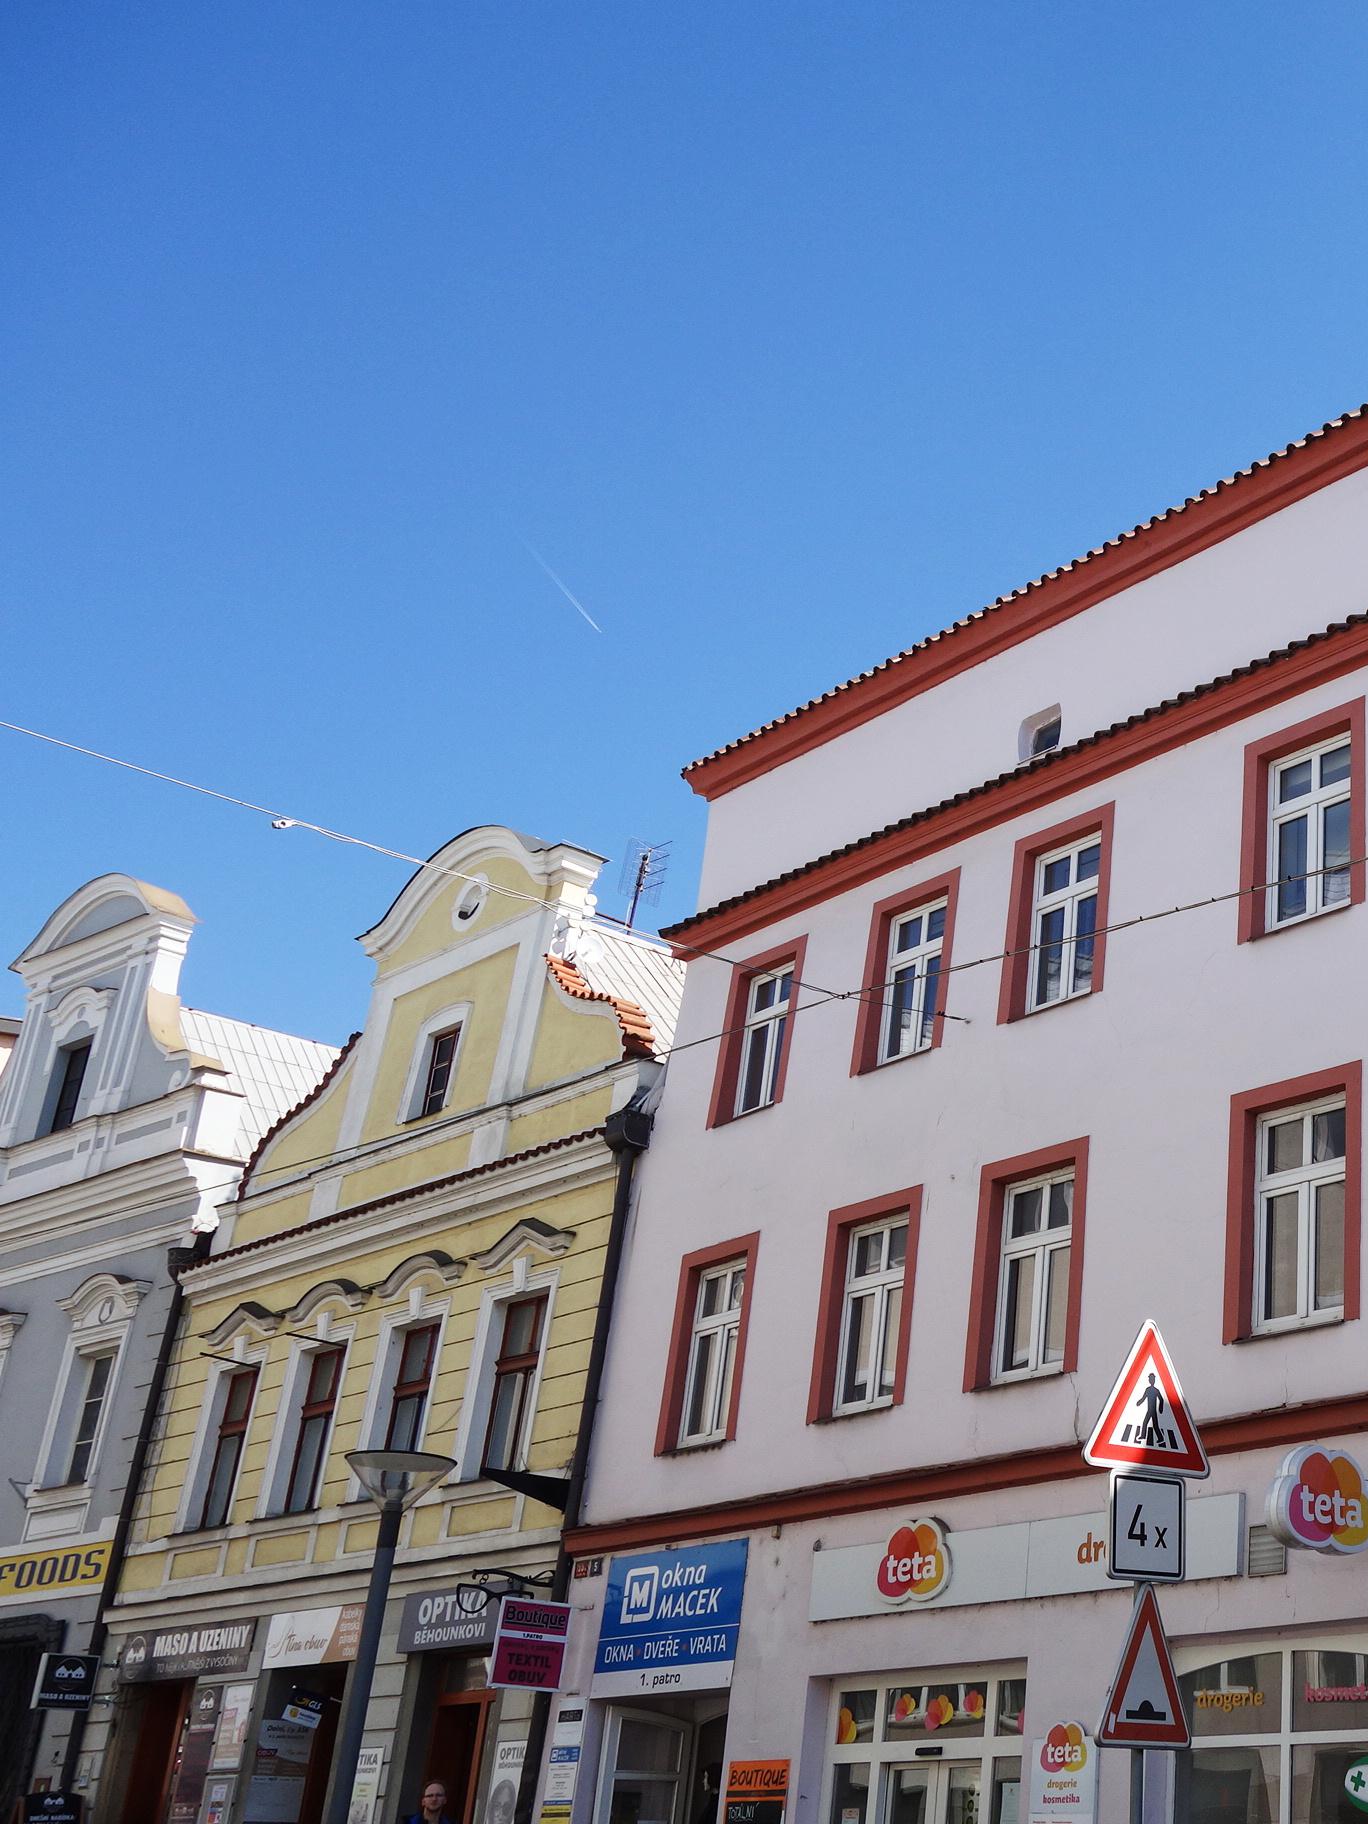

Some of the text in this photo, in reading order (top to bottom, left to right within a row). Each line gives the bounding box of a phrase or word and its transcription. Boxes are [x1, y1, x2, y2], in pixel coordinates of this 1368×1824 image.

[1300, 1485, 1364, 1528] teta
[1127, 1504, 1147, 1547] 4
[1077, 1532, 1106, 1564] dr
[0, 1549, 105, 1588] FOODS
[661, 1562, 707, 1588] okna
[887, 1552, 936, 1583] teta
[418, 1591, 488, 1625] OPTIKA
[656, 1587, 722, 1619] MACEK
[506, 1605, 566, 1629] Boutique
[152, 1625, 251, 1657] MASO A UZENINY
[413, 1623, 486, 1645] BĚHOUNKOVI
[508, 1653, 552, 1669] TEXTIL
[604, 1634, 726, 1664] OKNA DVEŘE VRATA
[508, 1670, 546, 1683] OBUV
[640, 1673, 681, 1688] 1. patro
[1196, 1686, 1264, 1713] drogerie
[1046, 1743, 1082, 1763] teta
[730, 1769, 787, 1786] BOUTIQUE
[1047, 1778, 1077, 1791] drogerie
[1042, 1793, 1080, 1804] kosmetika
